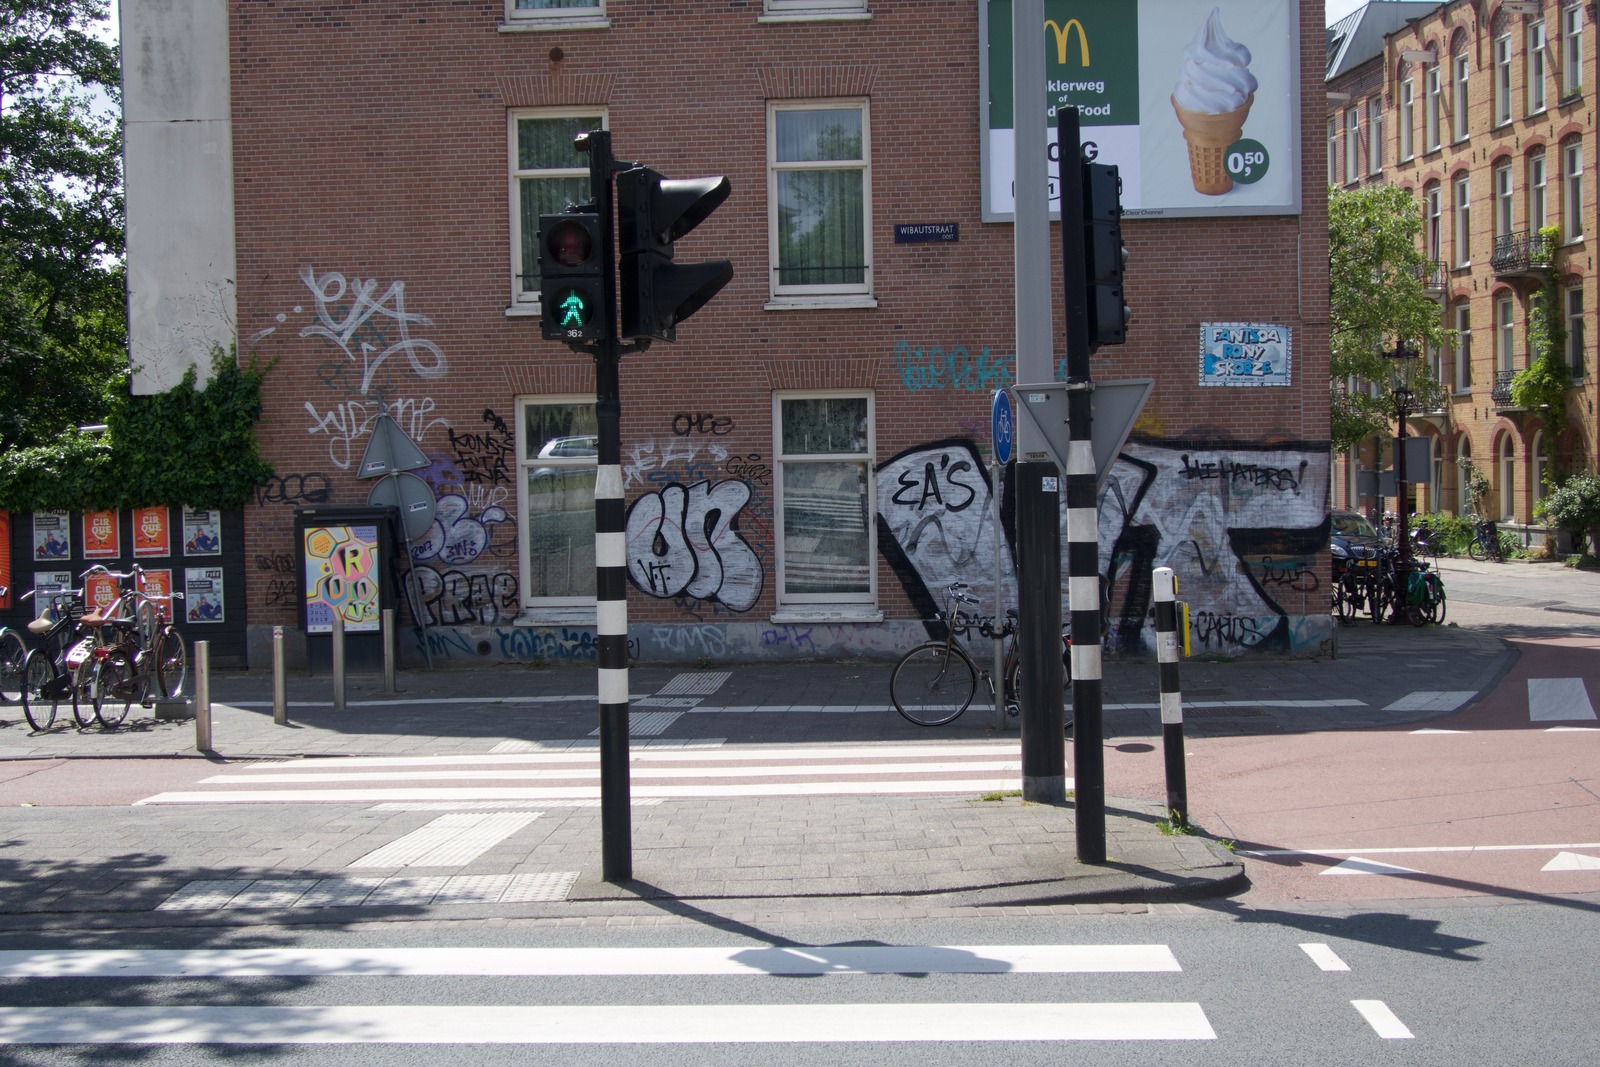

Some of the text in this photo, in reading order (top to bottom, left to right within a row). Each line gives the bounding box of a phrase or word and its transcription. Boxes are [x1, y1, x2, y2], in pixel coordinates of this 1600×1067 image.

[1046, 80, 1105, 94] klerweg
[1058, 95, 1068, 103] of
[900, 224, 954, 235] WIBAUTSTRAAT
[567, 329, 583, 338] 362
